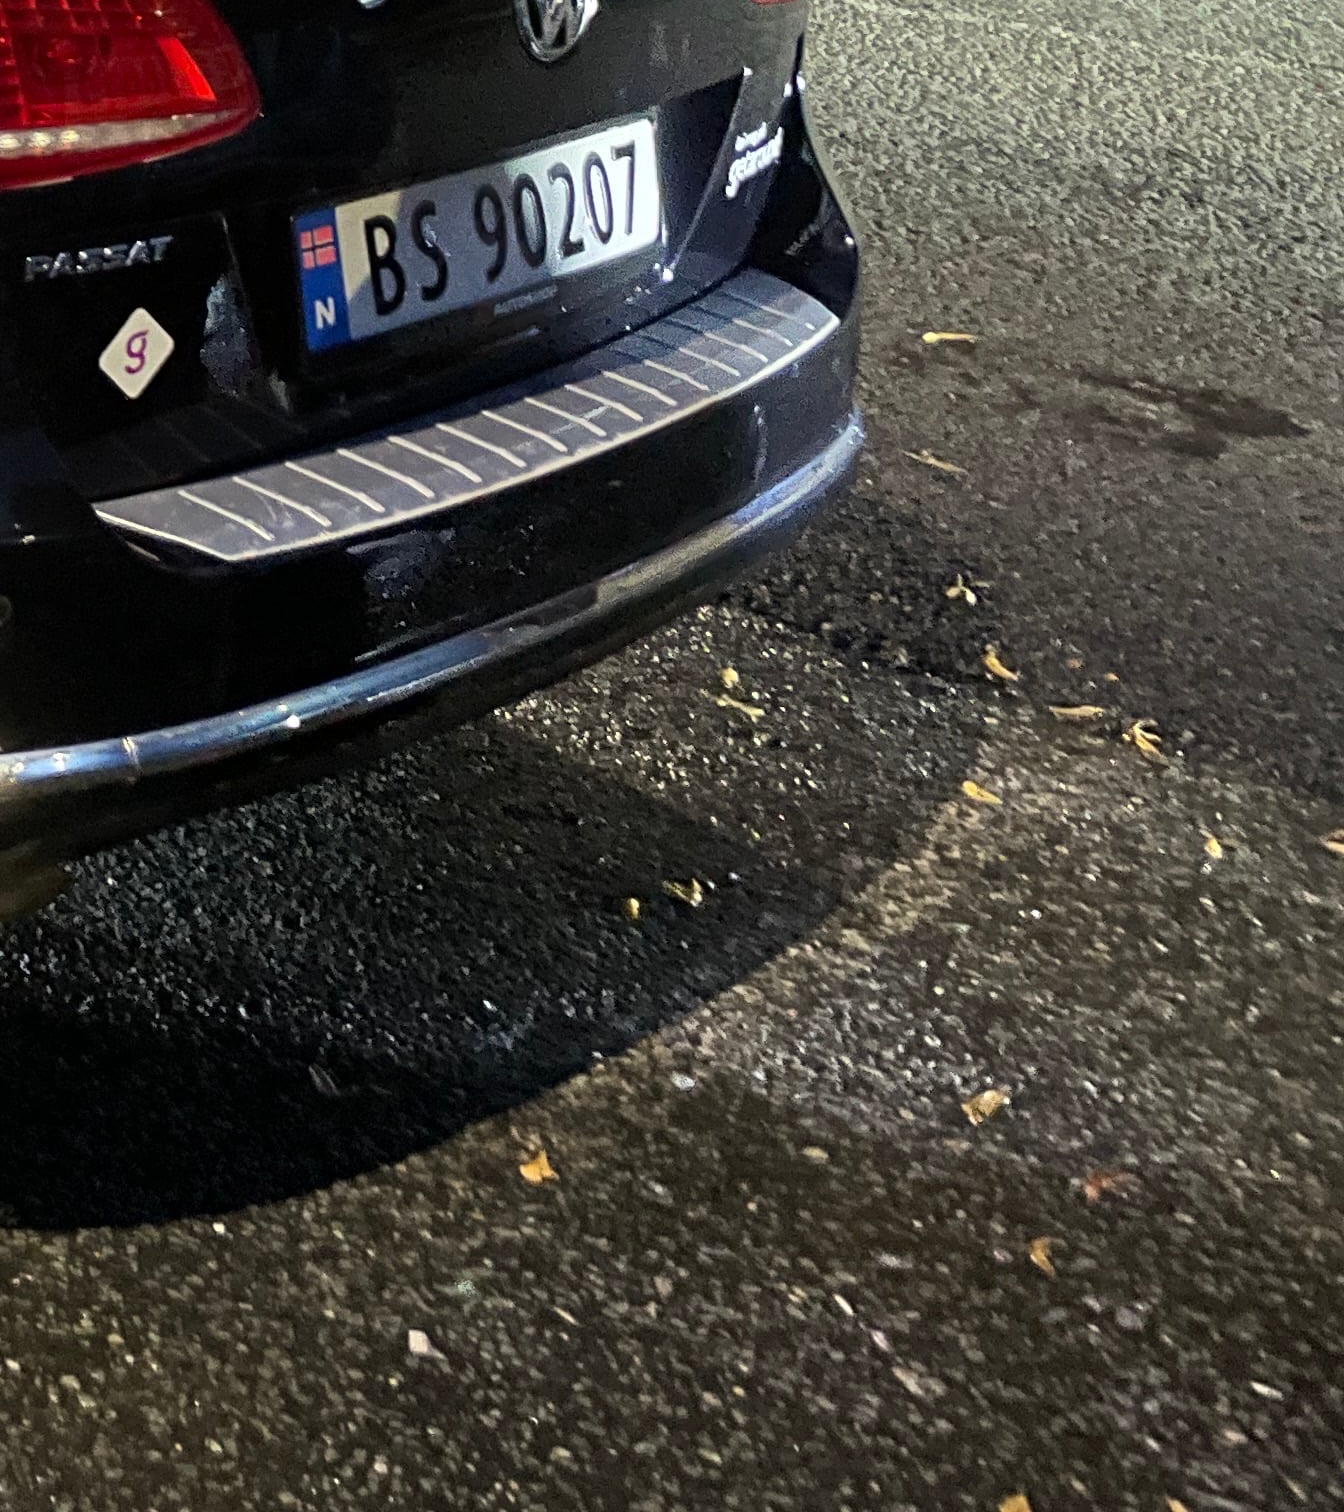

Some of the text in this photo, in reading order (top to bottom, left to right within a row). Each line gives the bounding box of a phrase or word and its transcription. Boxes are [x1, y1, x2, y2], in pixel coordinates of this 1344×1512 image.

[364, 139, 637, 317] BS 90207
[24, 235, 175, 283] PASSAT
[314, 296, 337, 330] N
